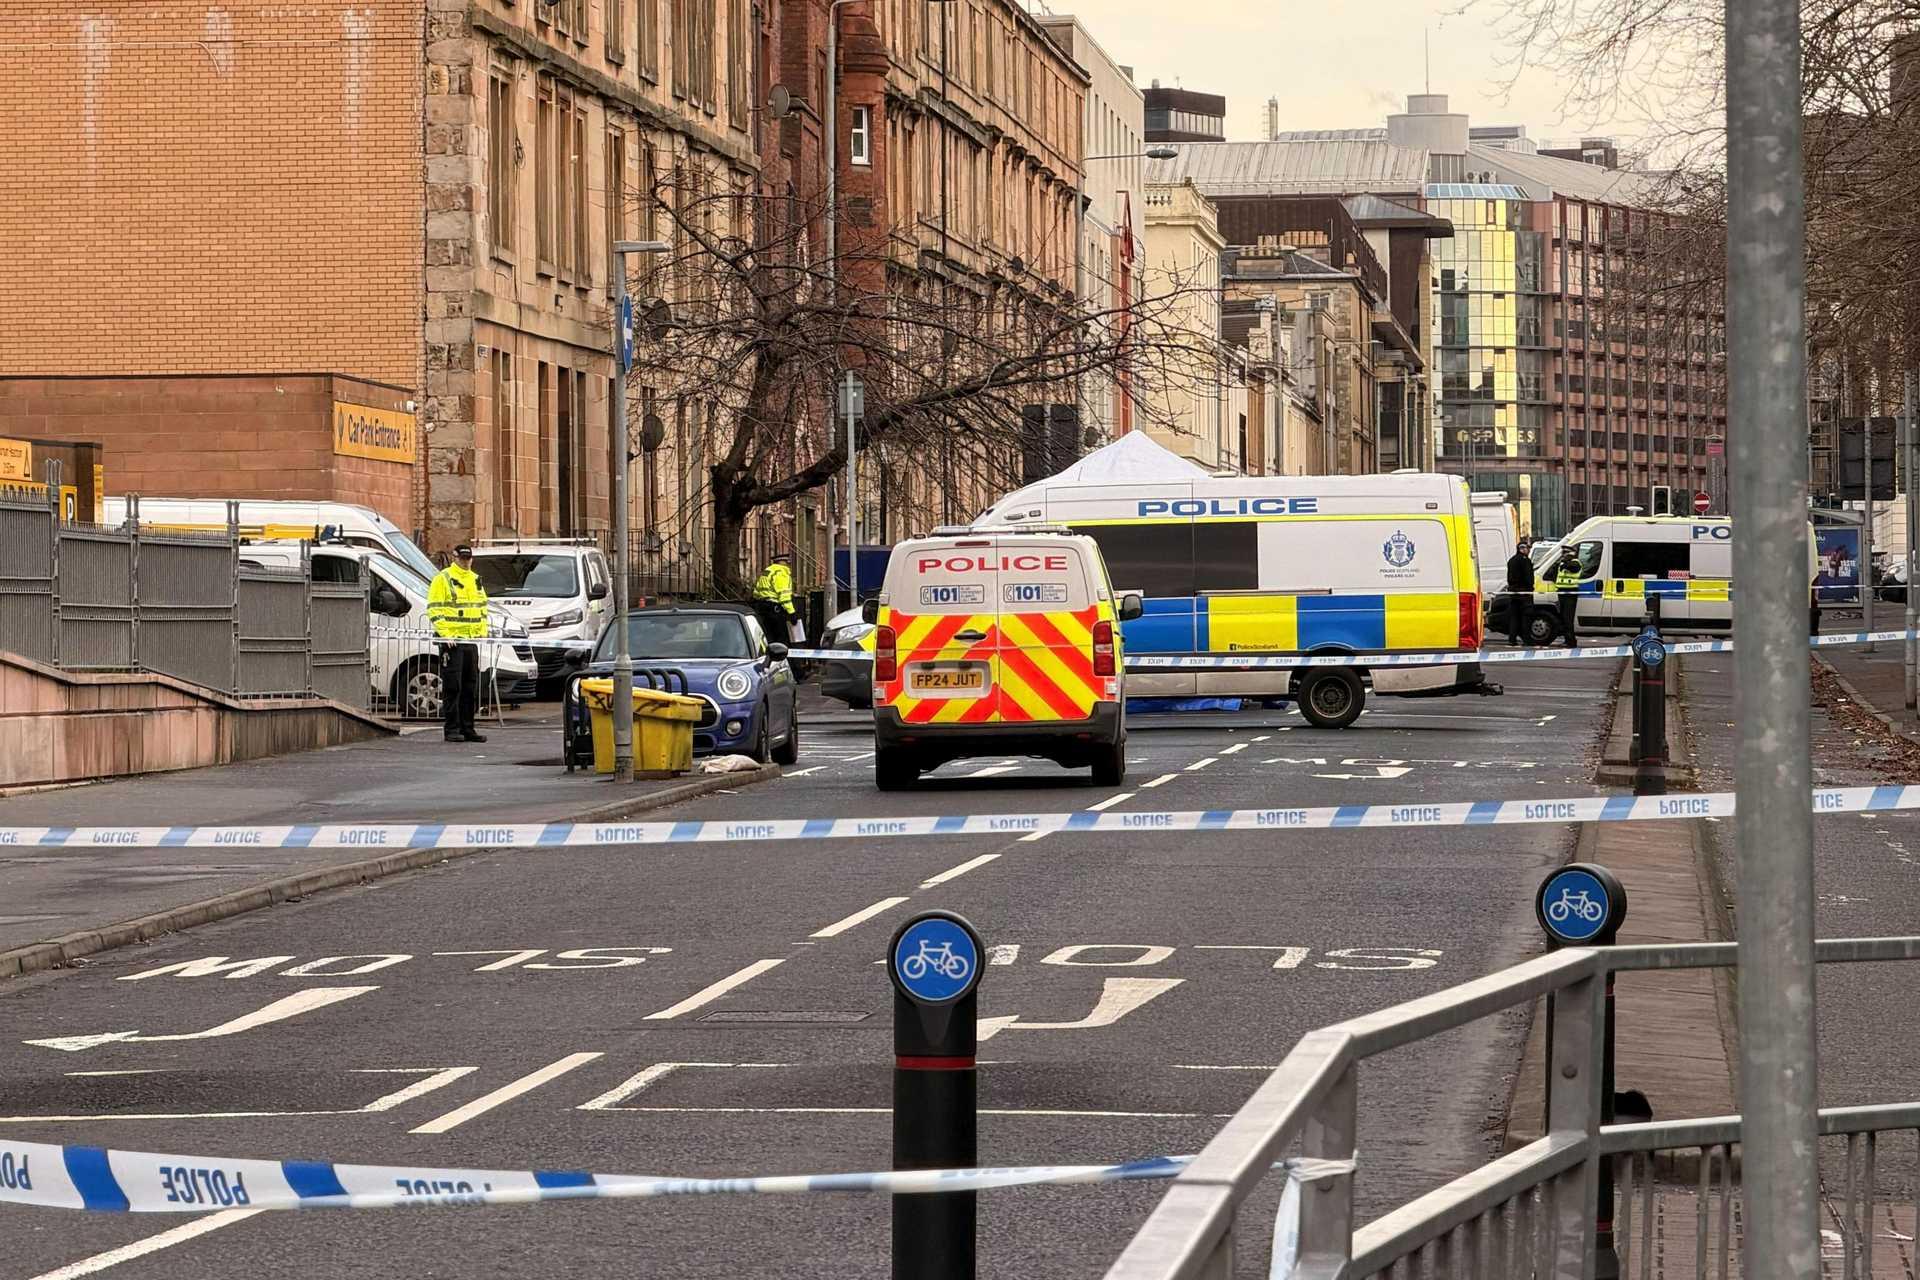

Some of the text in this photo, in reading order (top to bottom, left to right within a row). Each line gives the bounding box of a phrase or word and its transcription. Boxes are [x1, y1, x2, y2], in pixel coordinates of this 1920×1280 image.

[348, 413, 400, 449] Car Park Entrance
[1138, 498, 1317, 516] POLICE
[918, 556, 1068, 573] POLICE
[932, 588, 957, 602] 101
[1015, 586, 1040, 600] 101
[916, 673, 977, 687] FP24 JUT
[116, 947, 673, 980] SLOW
[160, 1166, 250, 1206] POLICE
